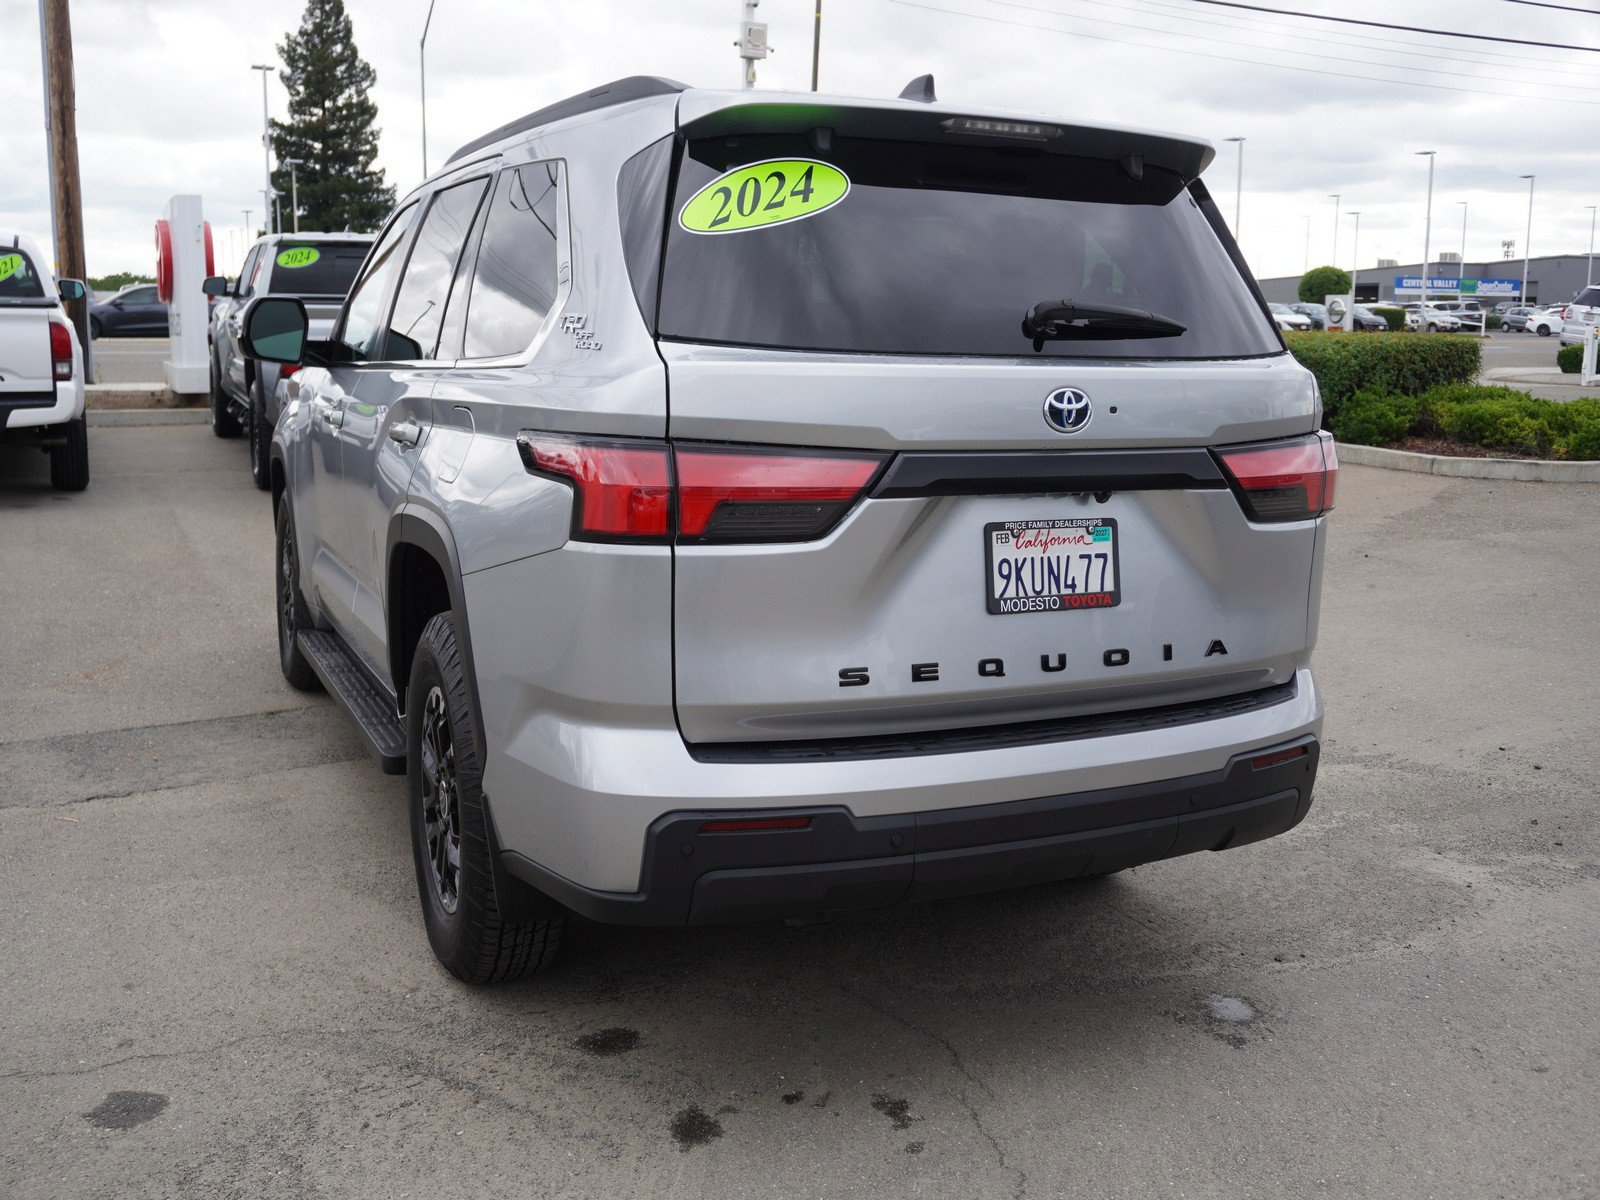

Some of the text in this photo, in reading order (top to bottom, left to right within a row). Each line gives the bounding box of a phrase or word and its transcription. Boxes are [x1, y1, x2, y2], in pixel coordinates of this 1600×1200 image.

[708, 165, 814, 229] 2024
[284, 249, 311, 265] 2024
[1433, 279, 1458, 288] VALLEY
[575, 331, 595, 341] OFF
[575, 341, 603, 351] ROAD
[1005, 519, 1102, 530] PRICE FAMILY DEALERSHIPS
[995, 532, 1010, 545] FEB
[1015, 529, 1094, 555] California
[997, 552, 1108, 598] 9KUN477
[1000, 593, 1112, 613] MODESTO TOYOTA
[838, 639, 1228, 688] SEQUOIA
